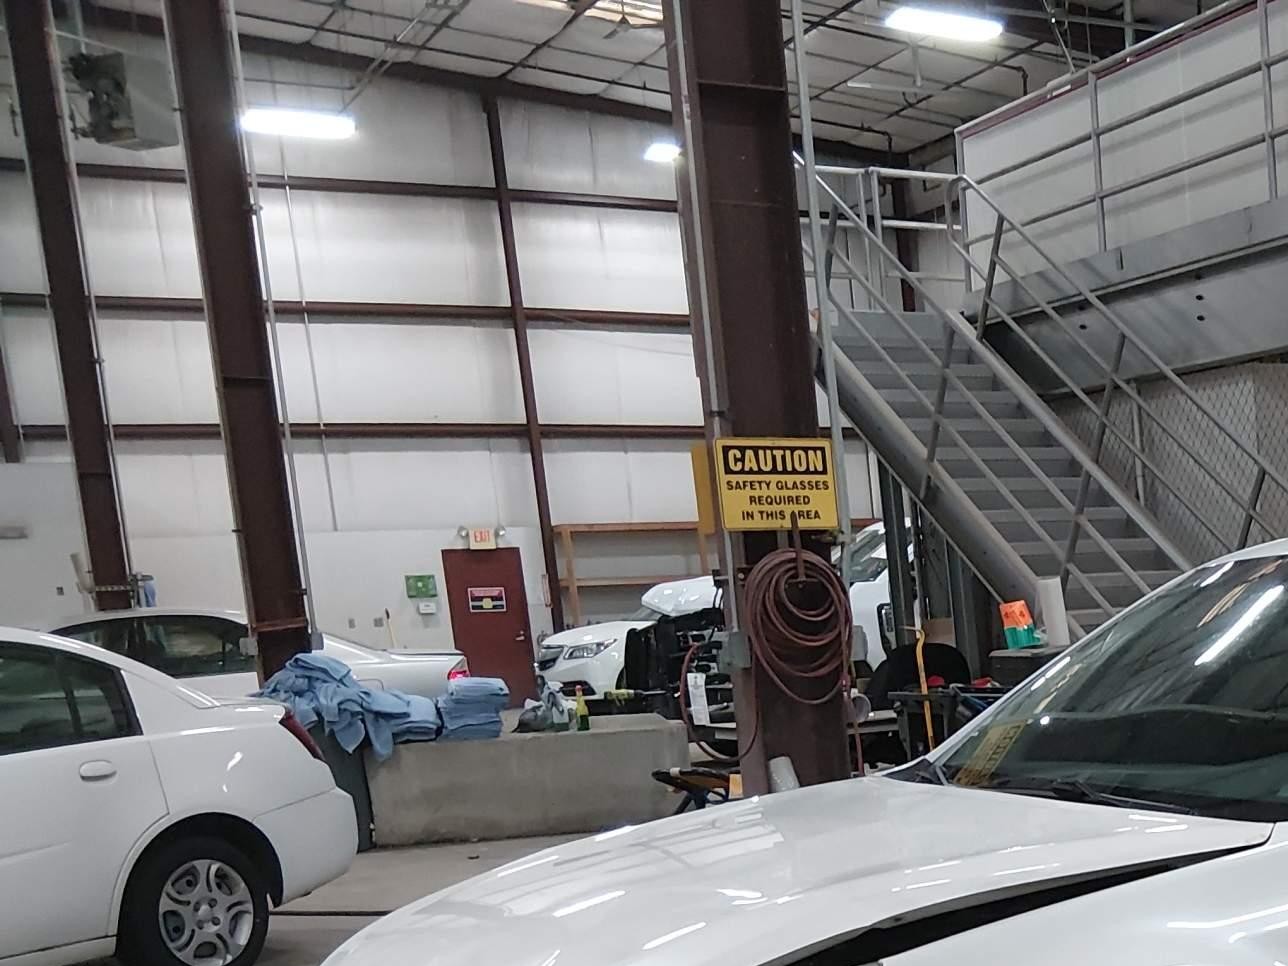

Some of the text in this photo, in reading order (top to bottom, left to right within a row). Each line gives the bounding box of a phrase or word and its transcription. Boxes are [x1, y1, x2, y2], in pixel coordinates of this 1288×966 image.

[728, 448, 824, 472] CAUTION
[726, 480, 830, 491] SAFETY GLASSES
[749, 495, 811, 506] REQUIRED
[741, 510, 822, 521] IN THIS REA
